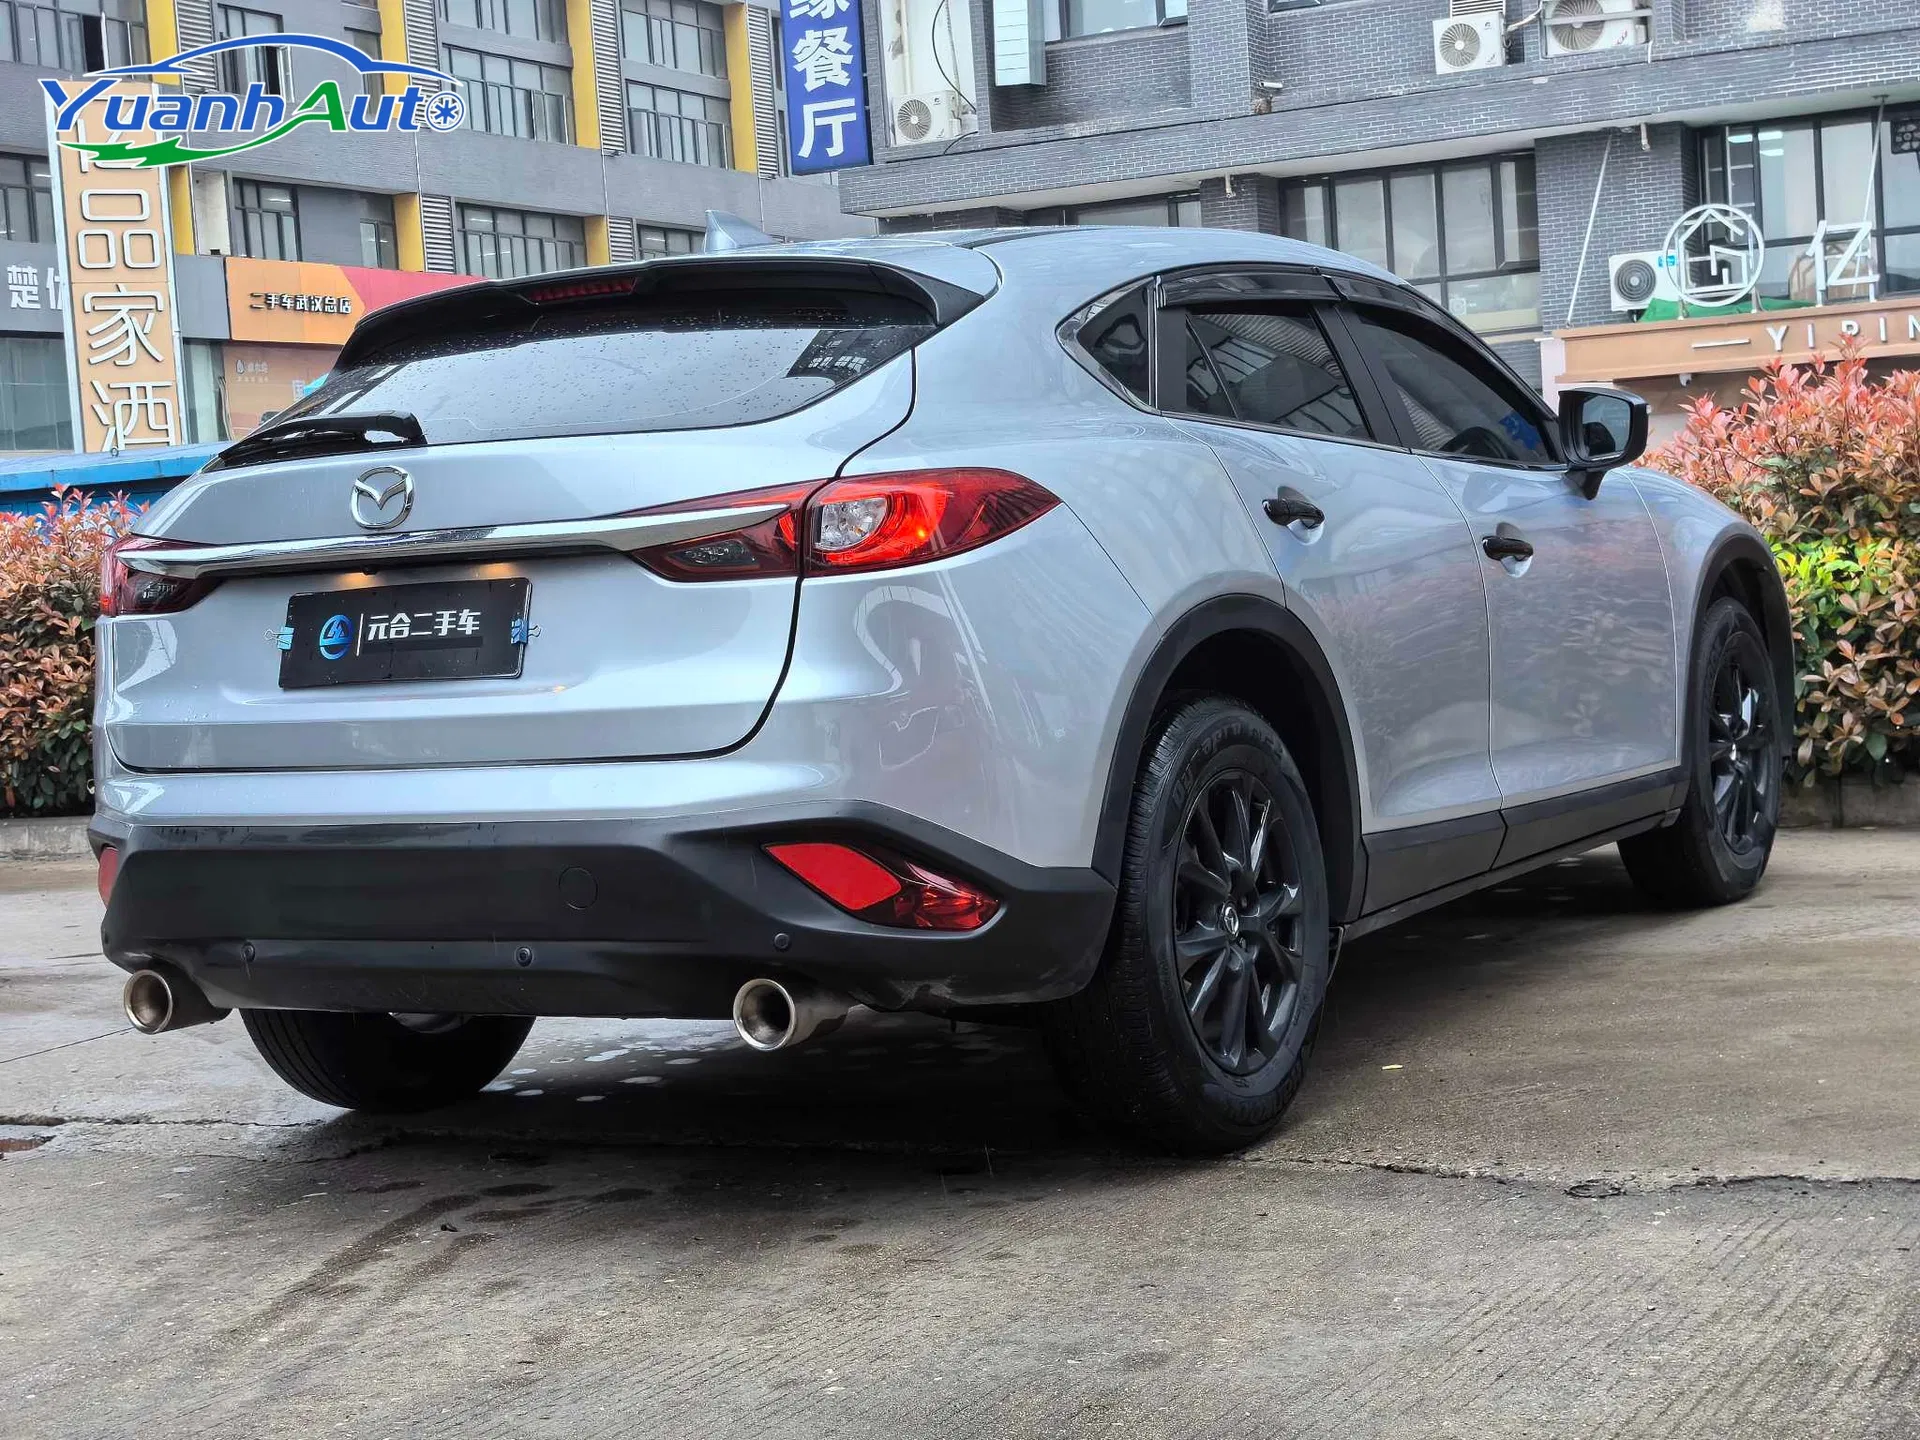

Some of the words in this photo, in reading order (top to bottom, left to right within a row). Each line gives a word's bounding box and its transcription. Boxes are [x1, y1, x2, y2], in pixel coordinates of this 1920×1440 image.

[249, 292, 352, 315] 二手车武汉总店
[367, 608, 482, 641] 元合二手车
